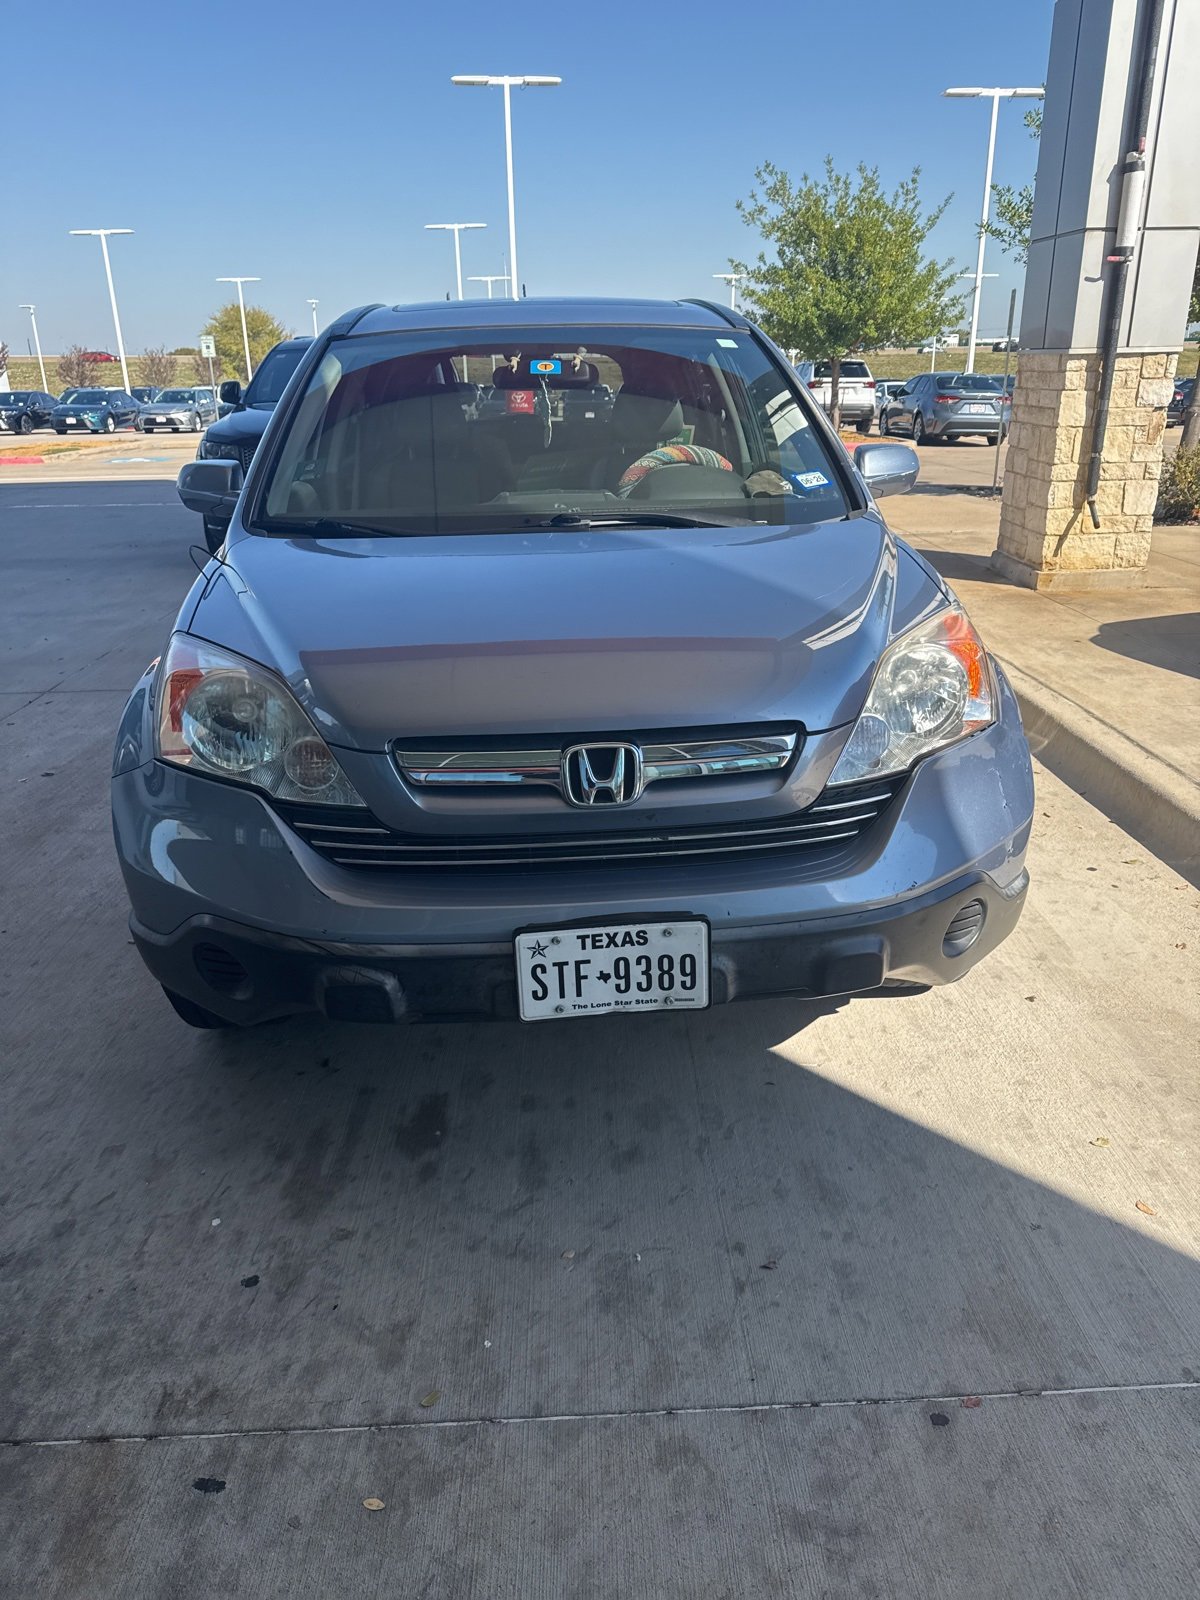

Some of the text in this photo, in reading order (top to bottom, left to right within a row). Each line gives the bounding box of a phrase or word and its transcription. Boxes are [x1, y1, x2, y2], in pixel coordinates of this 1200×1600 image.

[576, 929, 649, 950] TEXAS
[530, 953, 697, 1001] STF 9389
